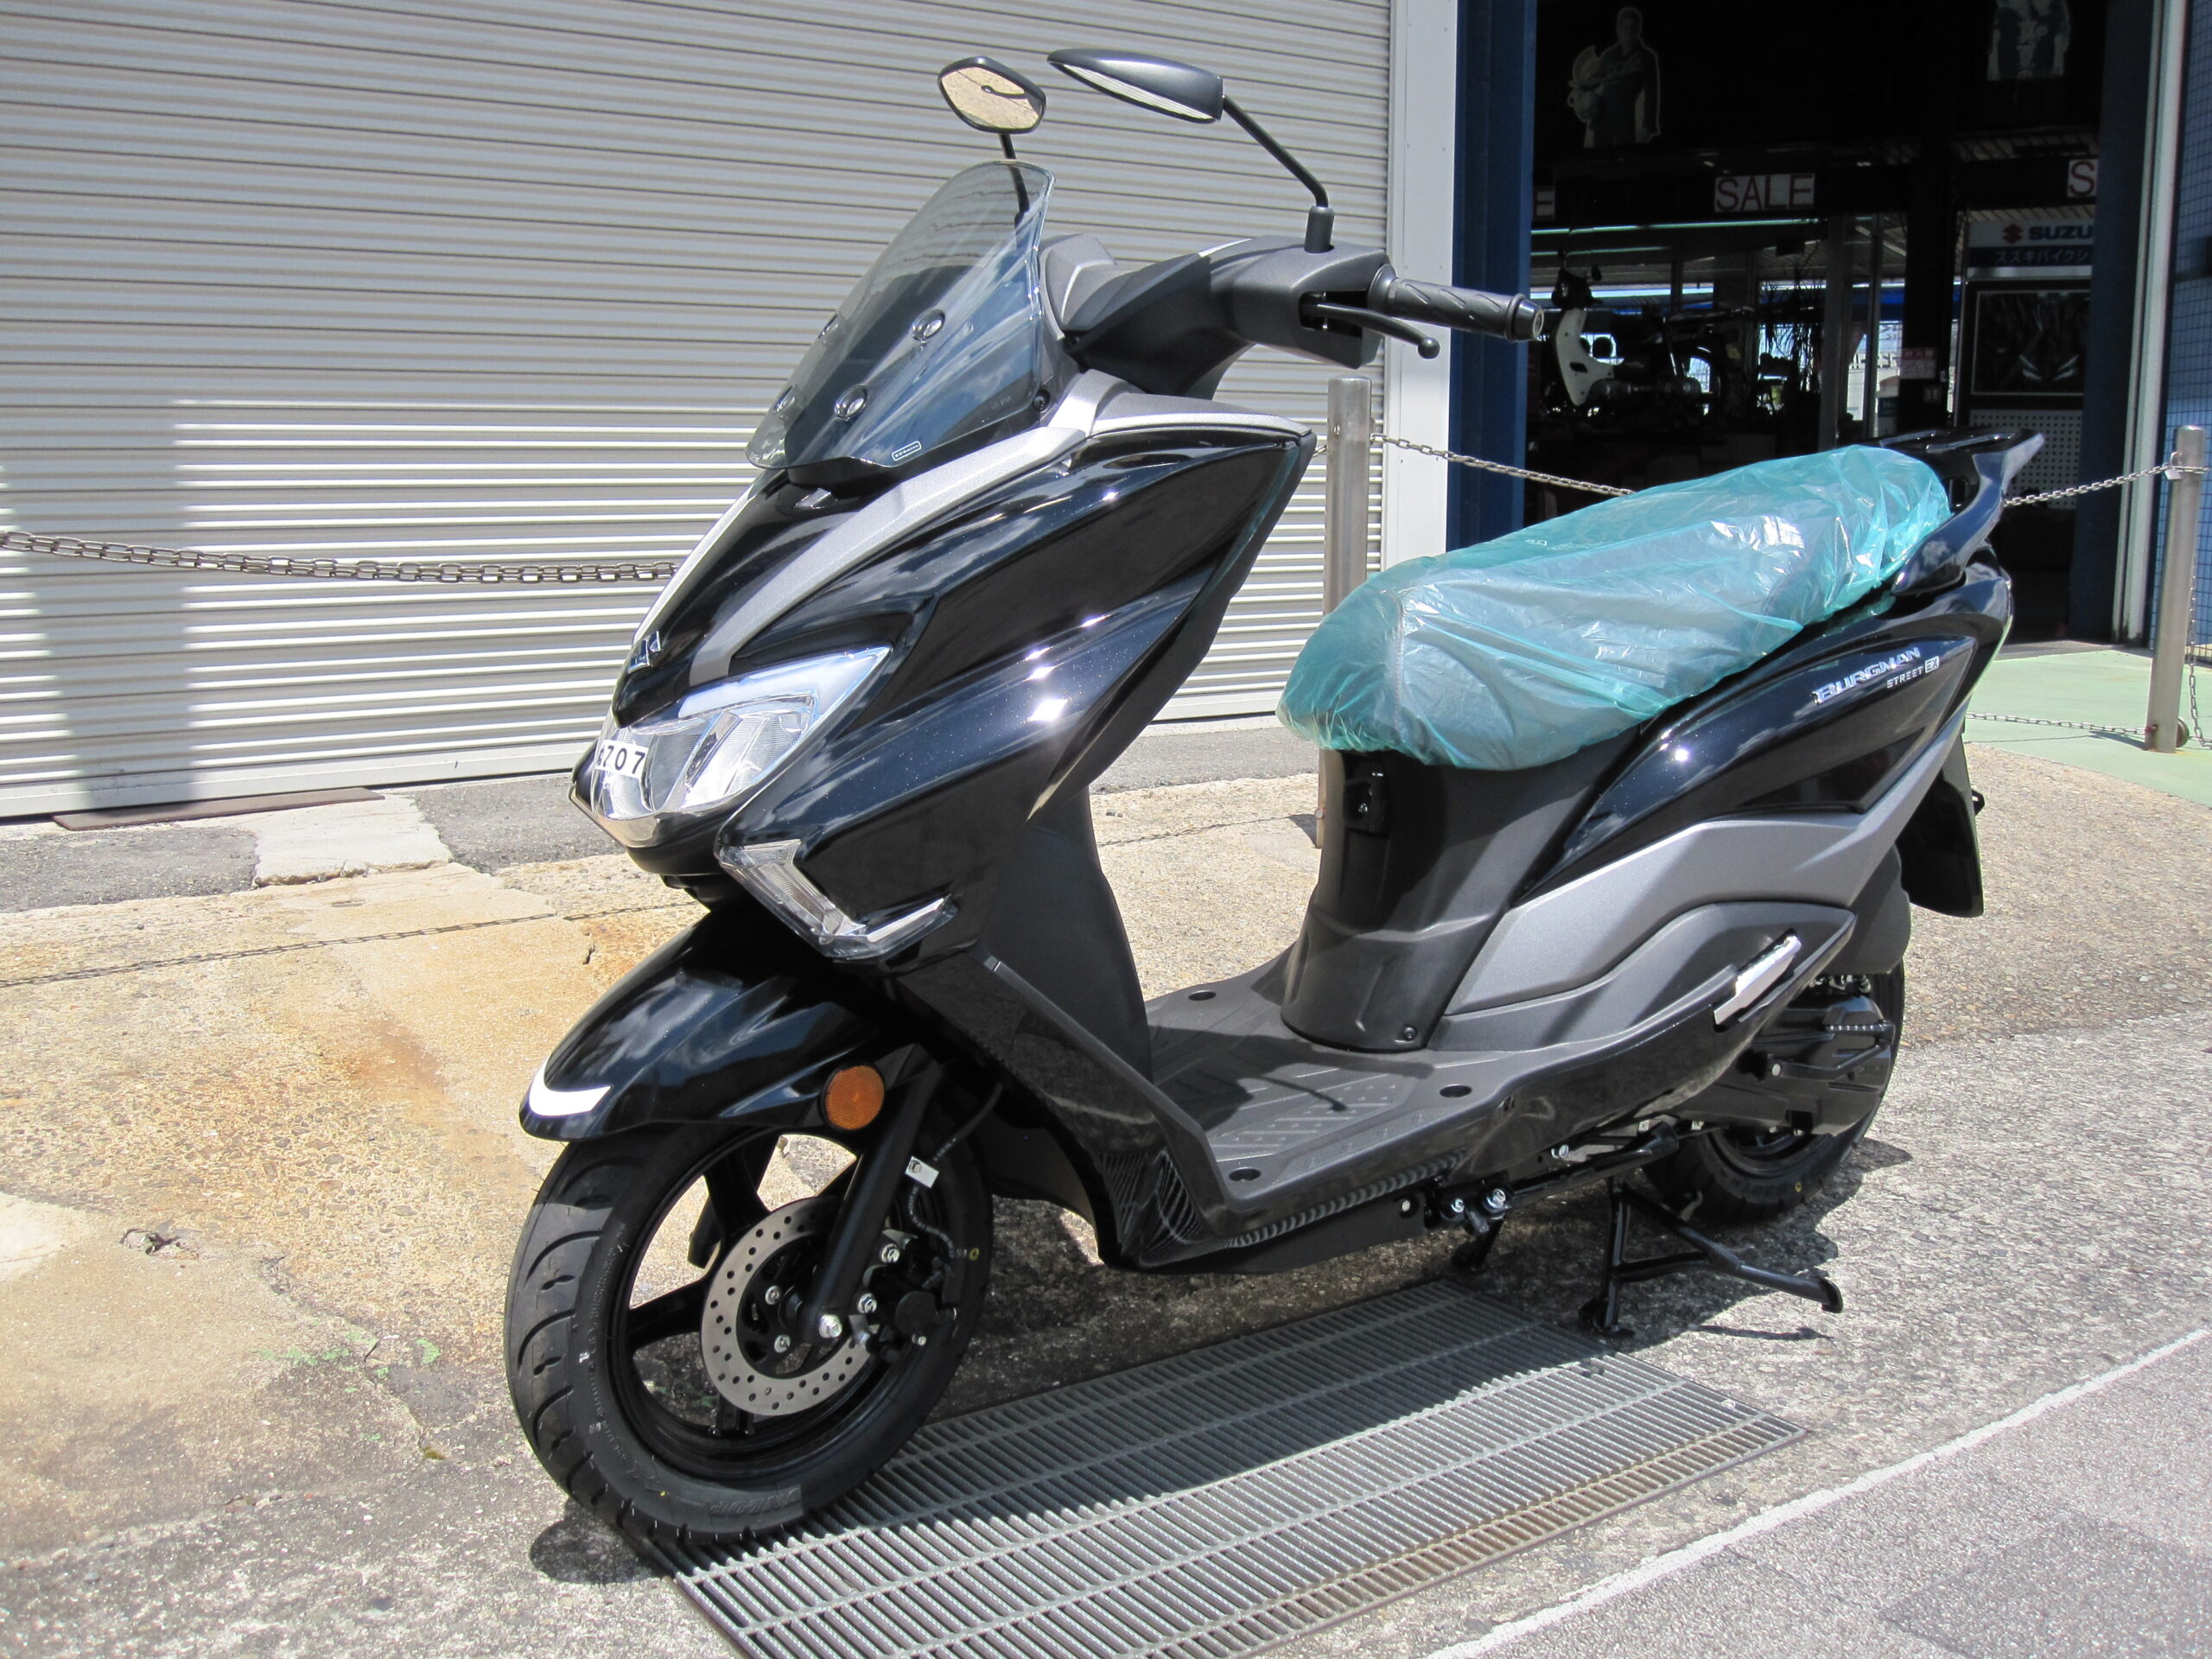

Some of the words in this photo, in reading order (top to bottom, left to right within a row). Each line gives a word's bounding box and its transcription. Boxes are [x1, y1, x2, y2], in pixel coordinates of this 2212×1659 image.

[1716, 174, 1814, 211] SALE
[1810, 646, 1922, 705] BURGMAN
[1886, 665, 1923, 689] STREET
[1925, 657, 1939, 673] EX
